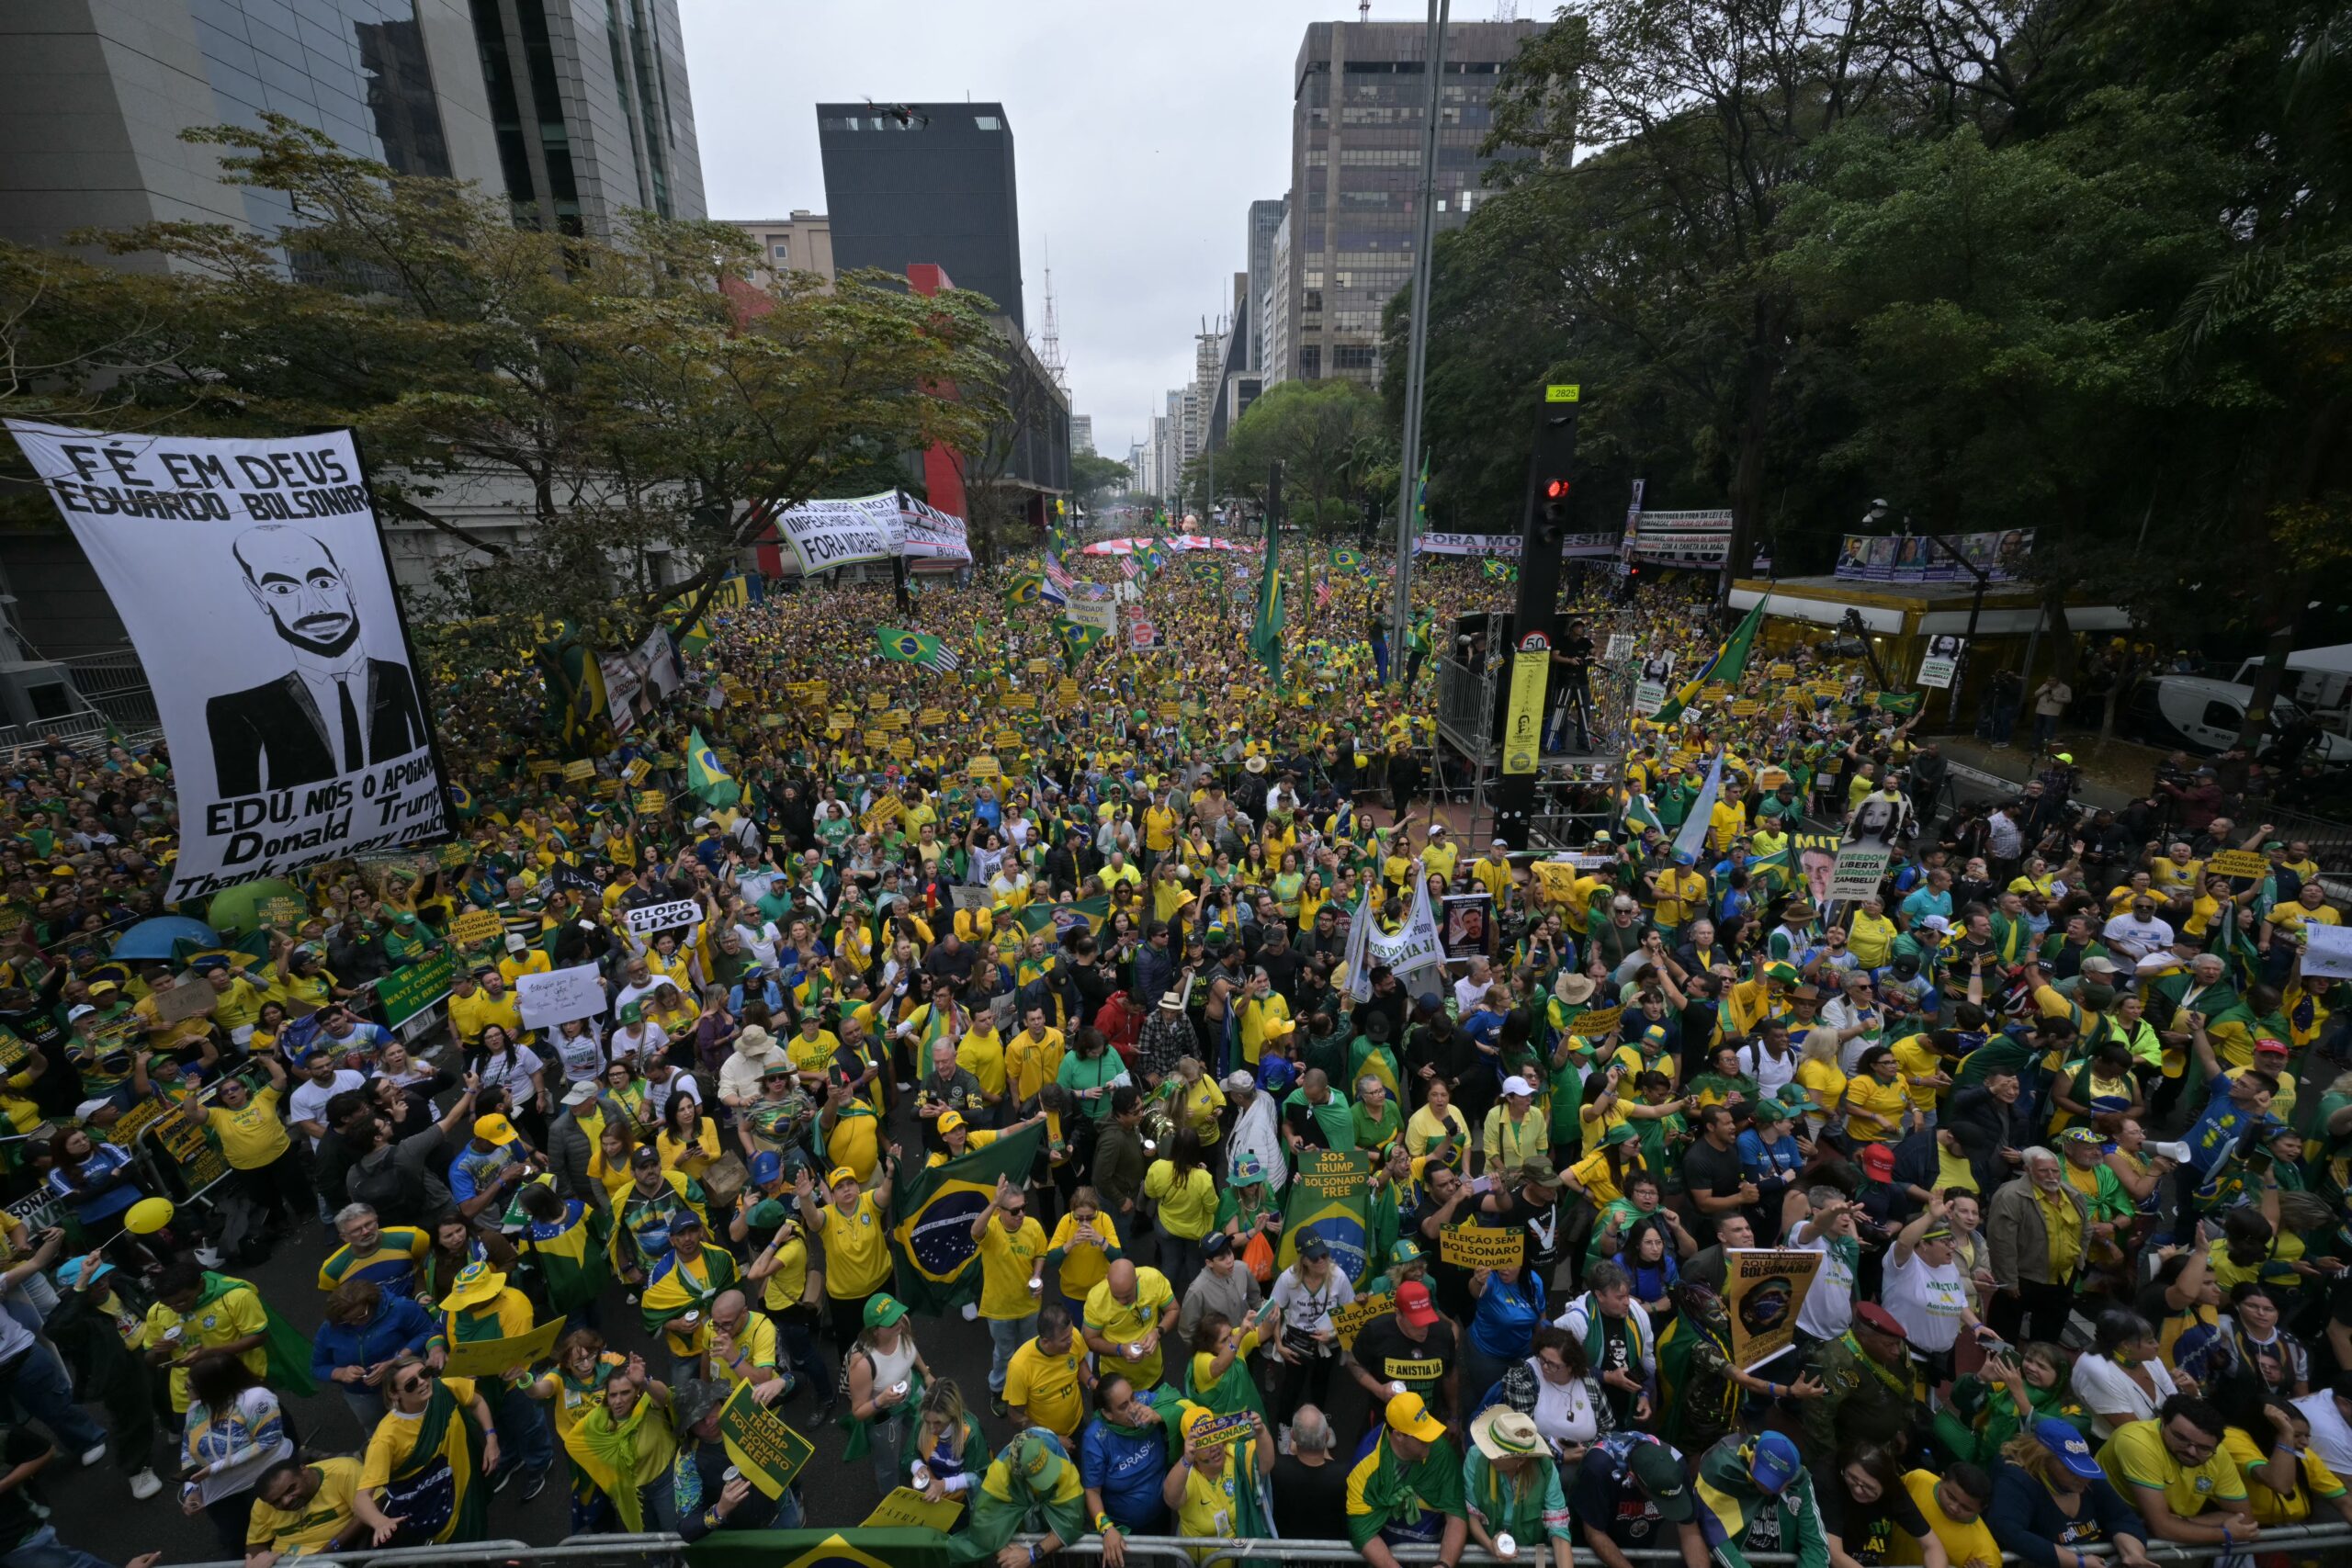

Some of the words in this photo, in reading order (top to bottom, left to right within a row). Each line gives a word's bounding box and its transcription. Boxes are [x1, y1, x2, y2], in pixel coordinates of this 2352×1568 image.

[1555, 389, 1576, 398] 2825
[61, 441, 154, 487] FÉ
[158, 453, 235, 490] EM
[234, 448, 349, 490] DEUS
[51, 478, 232, 522] EDUARDO
[786, 516, 854, 534] IMPEACHMENT
[1423, 533, 1476, 546] FORA
[802, 532, 847, 564] FORA
[1068, 603, 1104, 613] LIBERDADE
[1077, 615, 1099, 623] VOLTA
[1526, 637, 1544, 649] 50
[207, 787, 298, 836] EDÚ,
[304, 780, 353, 818] NÓS
[362, 778, 376, 798] O
[221, 807, 353, 867] Donald
[375, 785, 442, 828] Trump
[1794, 833, 1841, 852] MIT
[175, 858, 279, 901] Thank
[286, 848, 336, 874] you
[341, 829, 397, 859] very
[399, 808, 450, 843] much
[2217, 852, 2249, 862] ELEIÇÃO
[2212, 858, 2267, 870] BOLSONARO
[2222, 865, 2258, 875] DITADURA
[1833, 868, 1883, 876] LIBERDADE
[1833, 875, 1876, 885] ZAMBELLI
[266, 901, 296, 910] TRUMP
[631, 901, 692, 922] GLOBO
[258, 908, 303, 918] BOLSONARO
[452, 919, 500, 935] BOLSONARO
[454, 916, 481, 928] ELEIÇÃO
[481, 913, 495, 921] SEM
[634, 909, 695, 932] LIXO
[464, 927, 496, 938] DITADURA
[400, 970, 414, 982] WE
[385, 985, 412, 1007] WANT
[409, 996, 421, 1007] IN
[567, 1049, 594, 1062] ANISTIA
[112, 1112, 141, 1138] ELEIÇÃO
[141, 1102, 155, 1116] SEM
[2206, 1117, 2232, 1139] BRAZIL
[1321, 1152, 1345, 1162] SOS
[1316, 1162, 1354, 1173] TRUMP
[1305, 1175, 1364, 1188] BOLSONARO
[1322, 1186, 1351, 1198] FREE
[913, 1222, 940, 1235] ORDEM
[1447, 1232, 1492, 1246] ELEIÇÃO
[1495, 1235, 1516, 1244] SEM
[1442, 1242, 1521, 1256] BOLSONARO
[1453, 1252, 1459, 1260] É
[1461, 1257, 1513, 1267] DITADURA
[1741, 1265, 1813, 1278] BOLSONARO
[1926, 1281, 1961, 1292] ANISTIA
[1927, 1302, 1939, 1310] Aos
[1337, 1306, 1376, 1324] ELEIÇÃO
[1396, 1364, 1431, 1376] ANISTIA
[1432, 1361, 1442, 1374] JÁ
[760, 1410, 786, 1436] SOS
[1193, 1421, 1217, 1434] VOLTA
[748, 1411, 788, 1451] TRUMP
[1195, 1422, 1252, 1448] BOLSONARO
[729, 1412, 790, 1471] BOLSONARO
[738, 1435, 770, 1469] FREE
[1118, 1439, 1155, 1471] BRASIL
